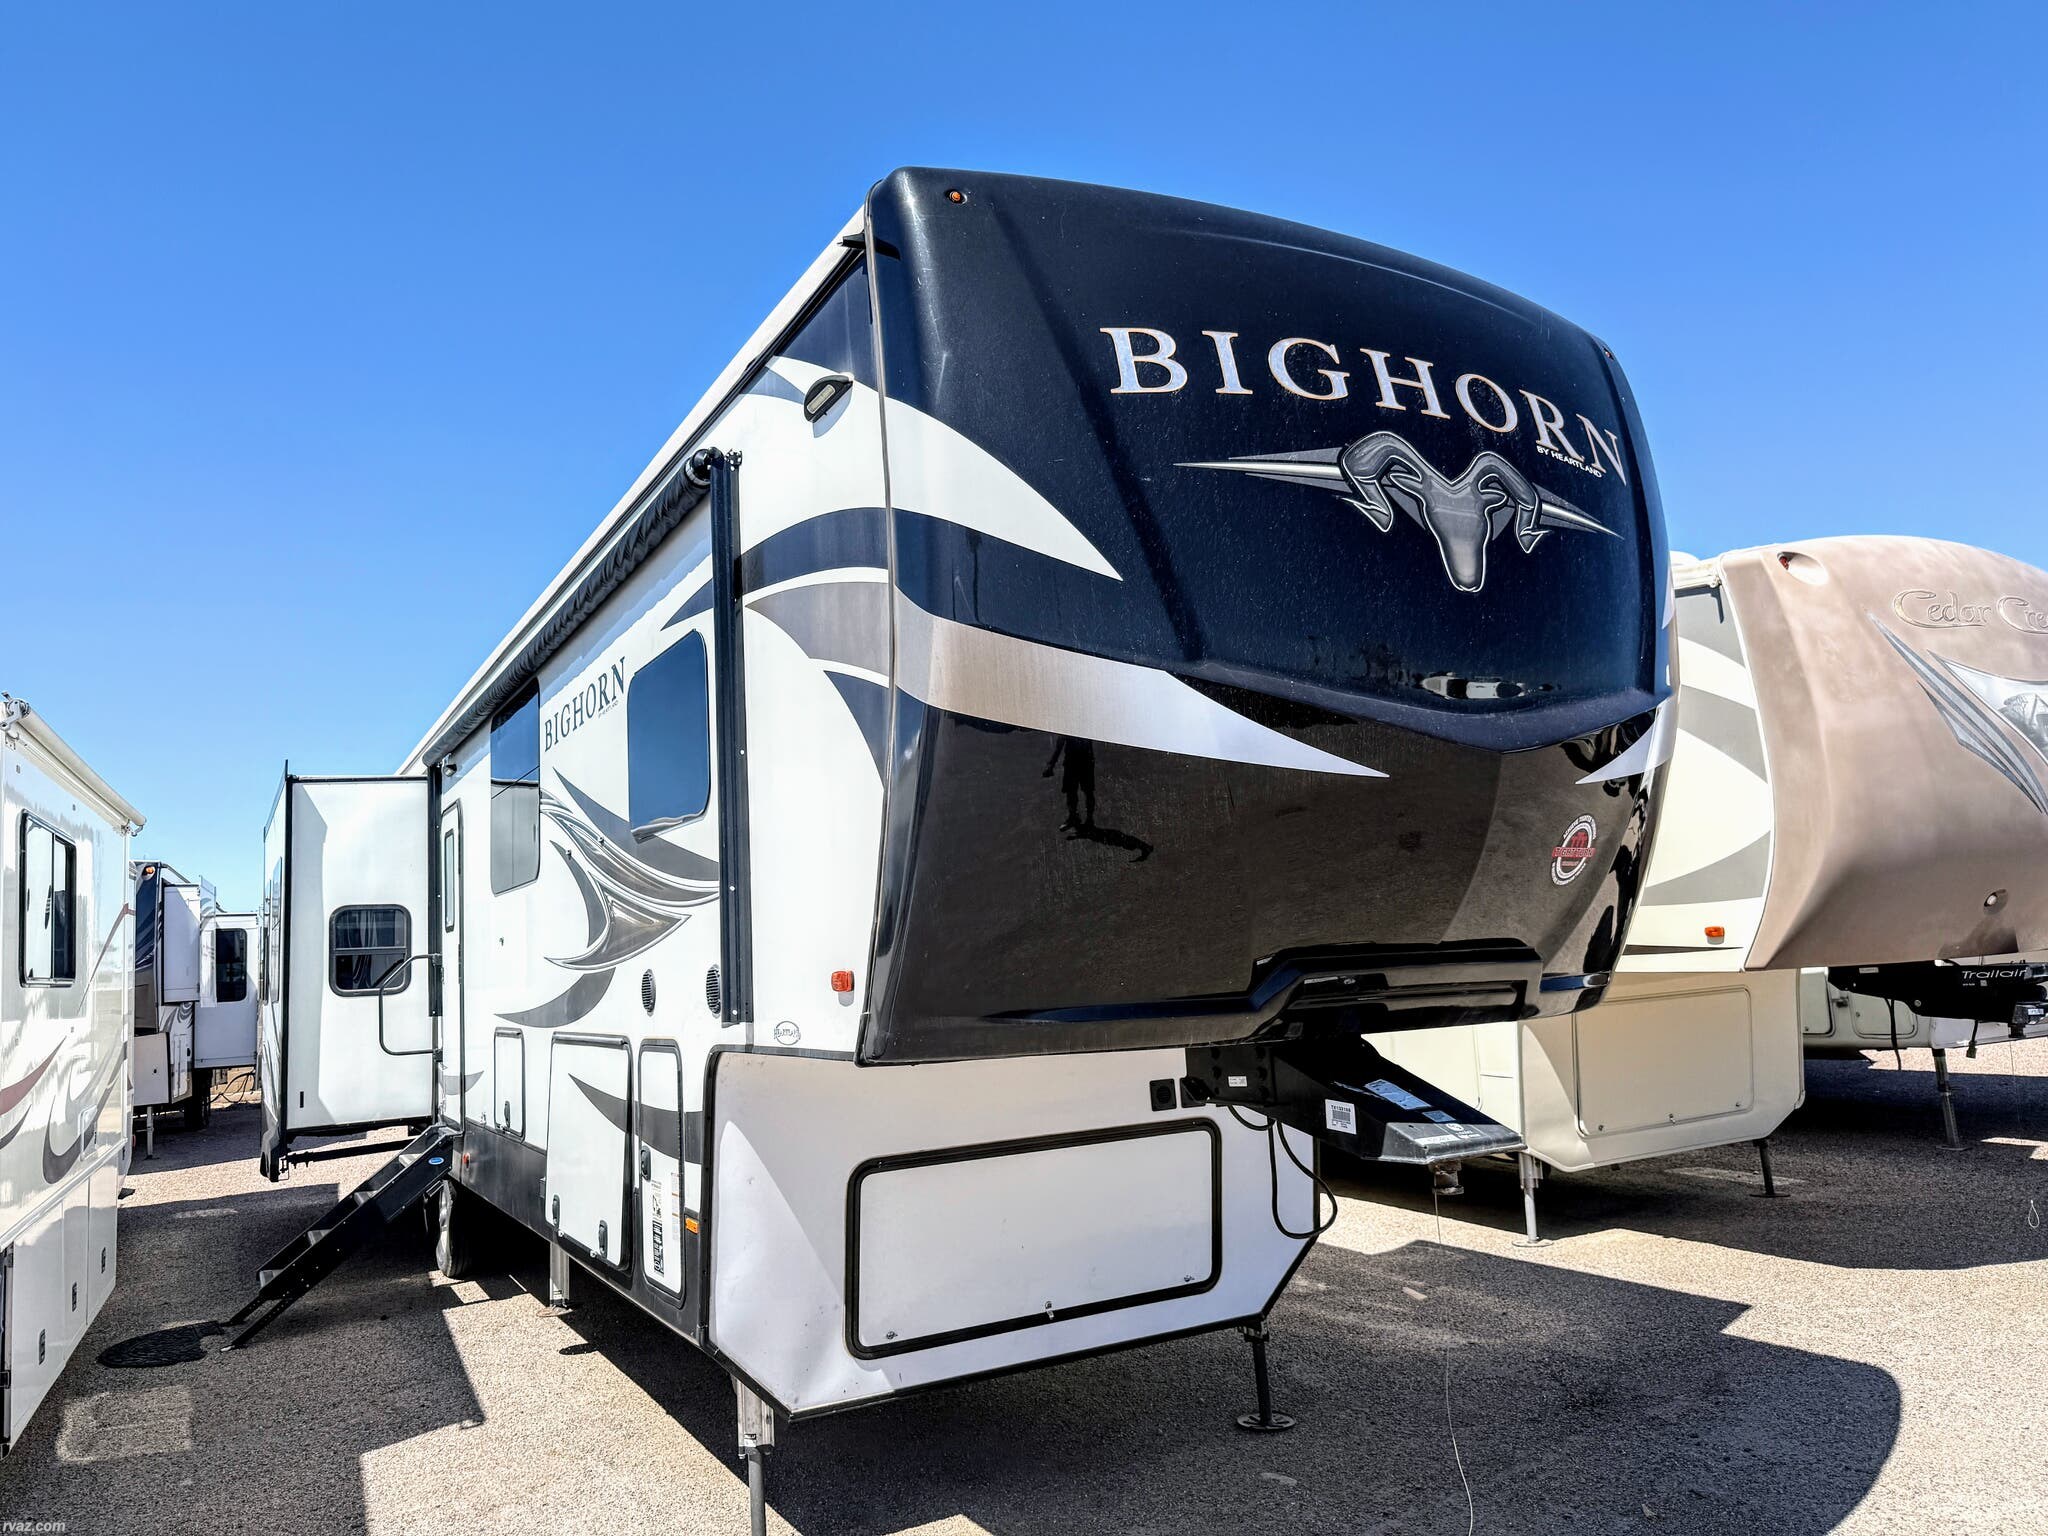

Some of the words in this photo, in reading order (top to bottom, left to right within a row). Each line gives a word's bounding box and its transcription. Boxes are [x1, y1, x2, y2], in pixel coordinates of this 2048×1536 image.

[1100, 327, 1627, 486] BIGHORN
[1536, 445, 1550, 455] BY
[1550, 450, 1602, 478] HEARTLAND
[1894, 589, 1992, 628] Cedar
[545, 656, 625, 752] BIGHORN
